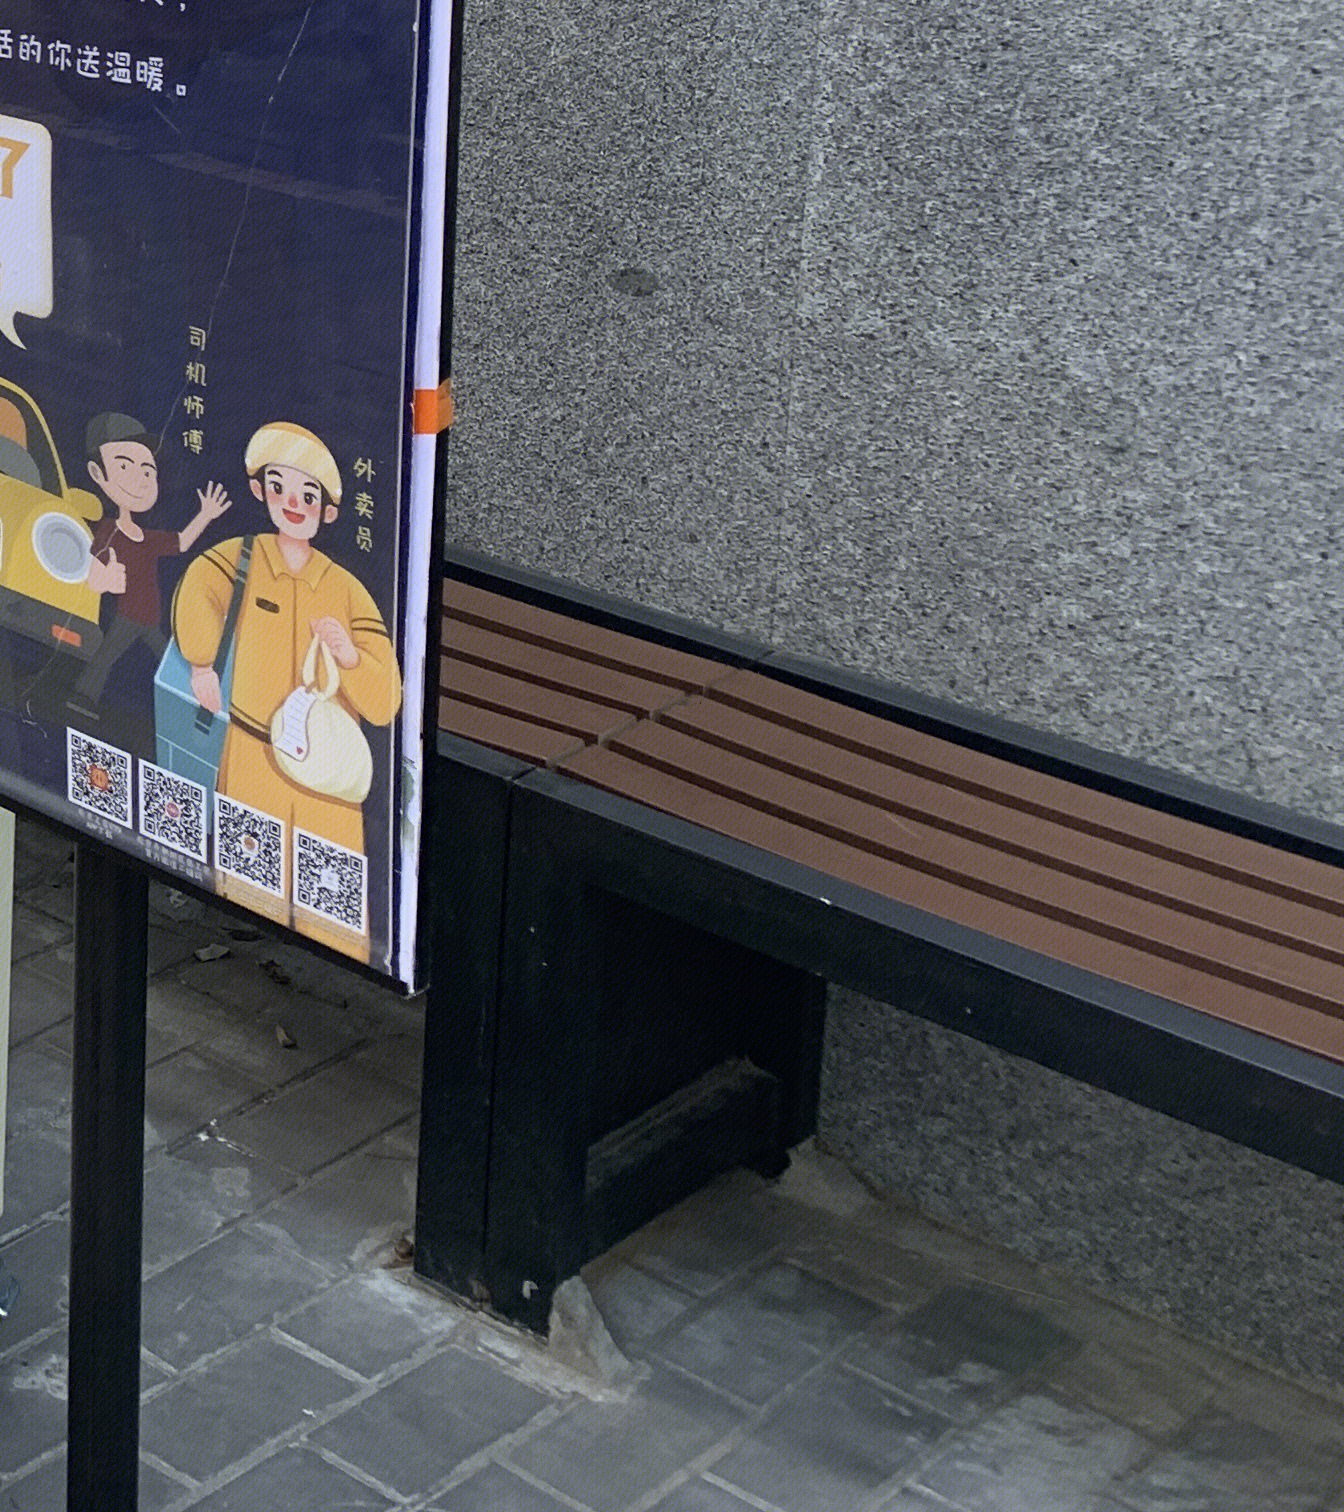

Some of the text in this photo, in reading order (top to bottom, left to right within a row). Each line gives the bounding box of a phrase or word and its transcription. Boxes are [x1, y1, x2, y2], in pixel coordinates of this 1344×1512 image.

[182, 325, 209, 456] 司机师傅
[352, 455, 378, 553] 外卖员
